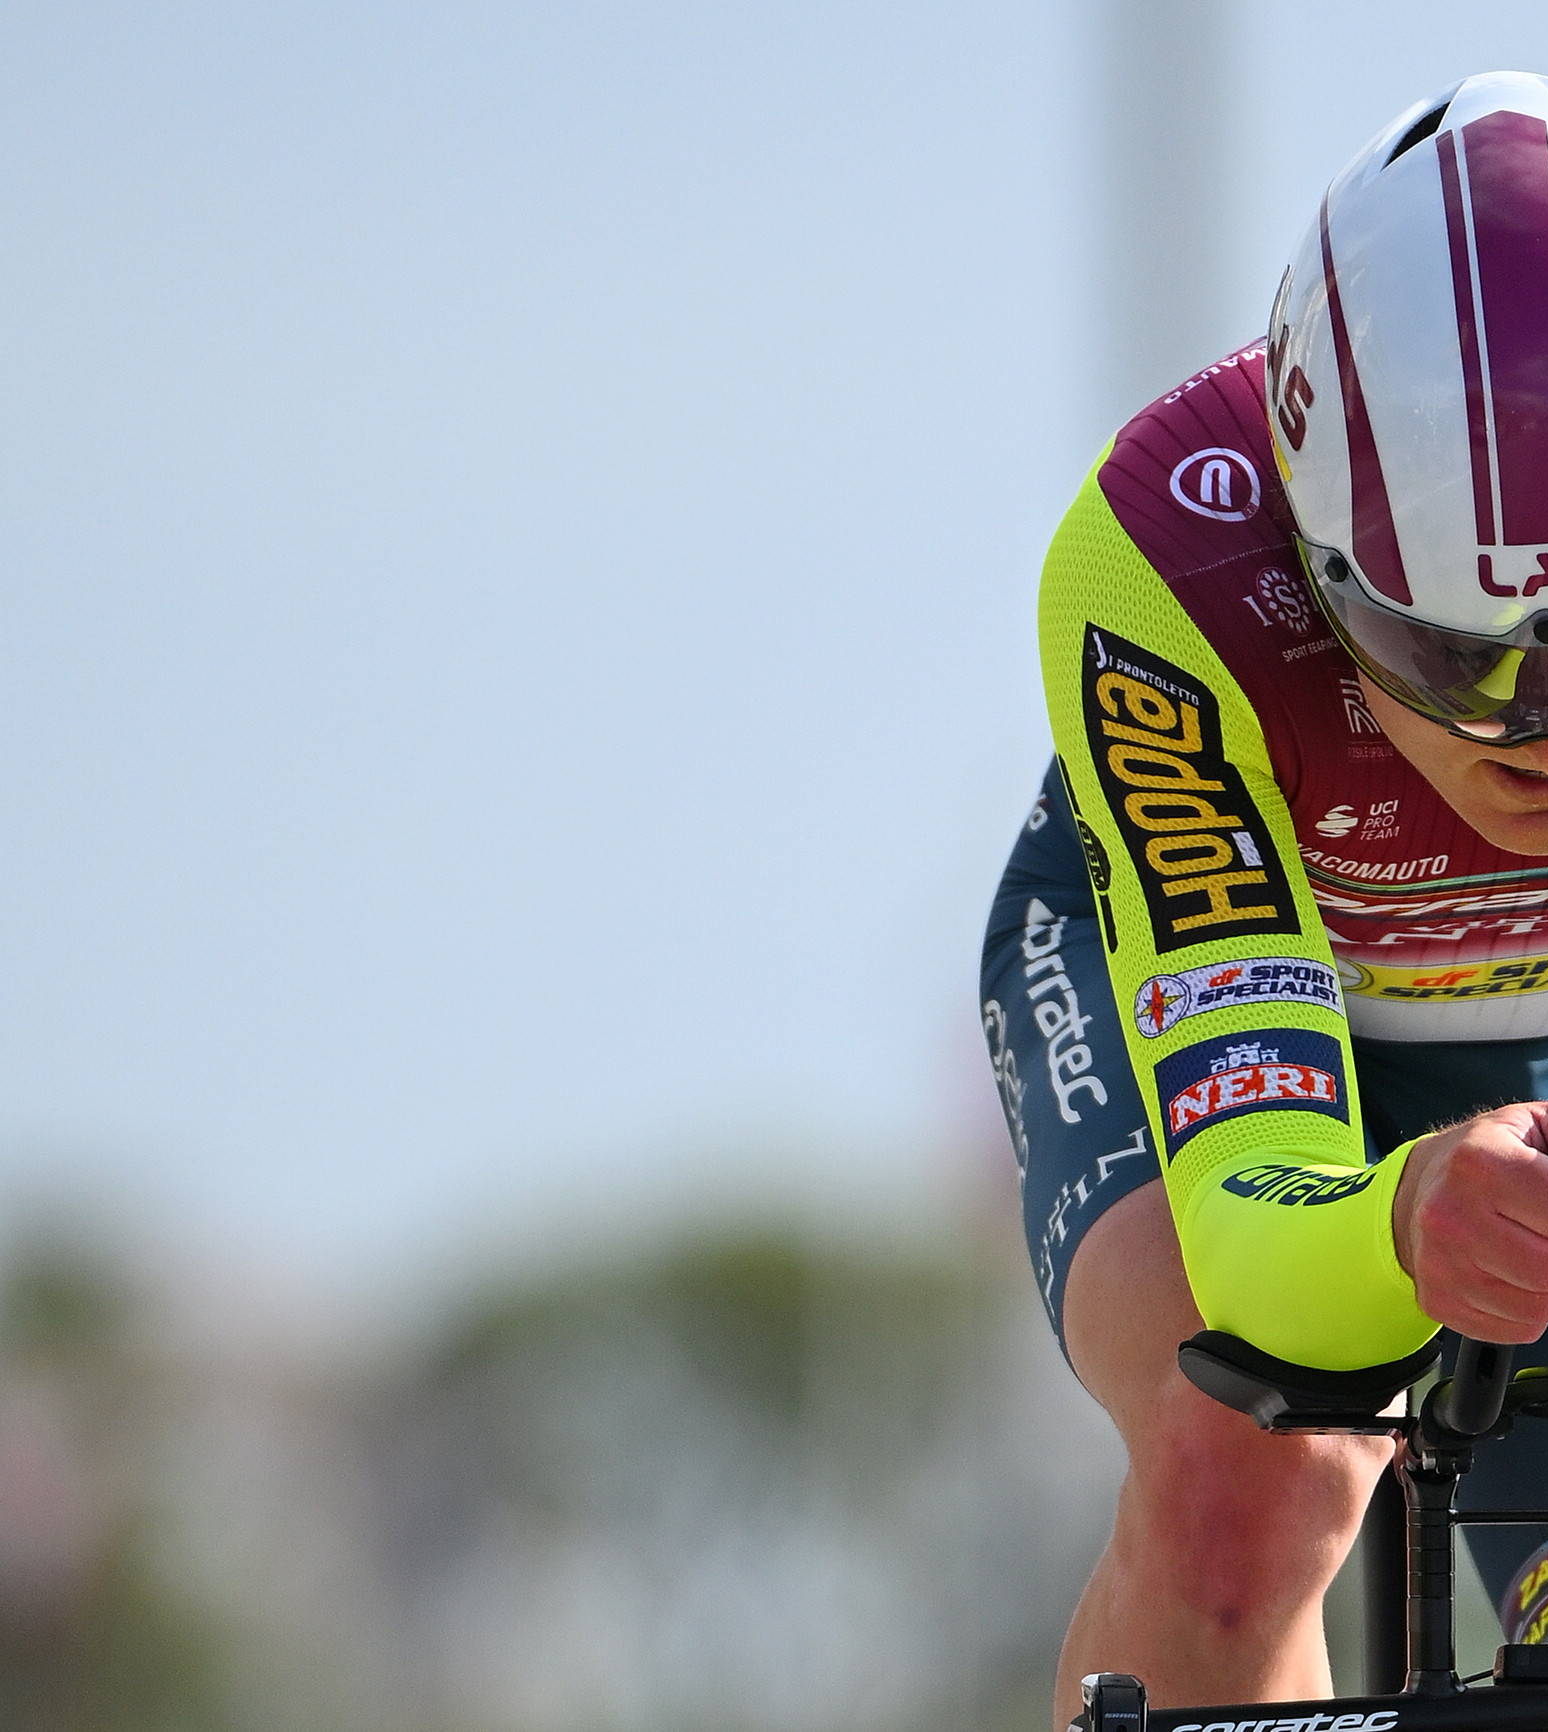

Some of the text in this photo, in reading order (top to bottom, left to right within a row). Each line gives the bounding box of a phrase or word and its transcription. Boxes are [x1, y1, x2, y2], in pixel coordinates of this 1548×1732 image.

[1370, 800, 1399, 816] UCI
[1363, 815, 1395, 830] PRO
[1359, 826, 1401, 841] TEAM
[1250, 965, 1335, 989] SPORT
[1196, 981, 1339, 1006] SPECIALIST
[1172, 1066, 1333, 1129] NERI
